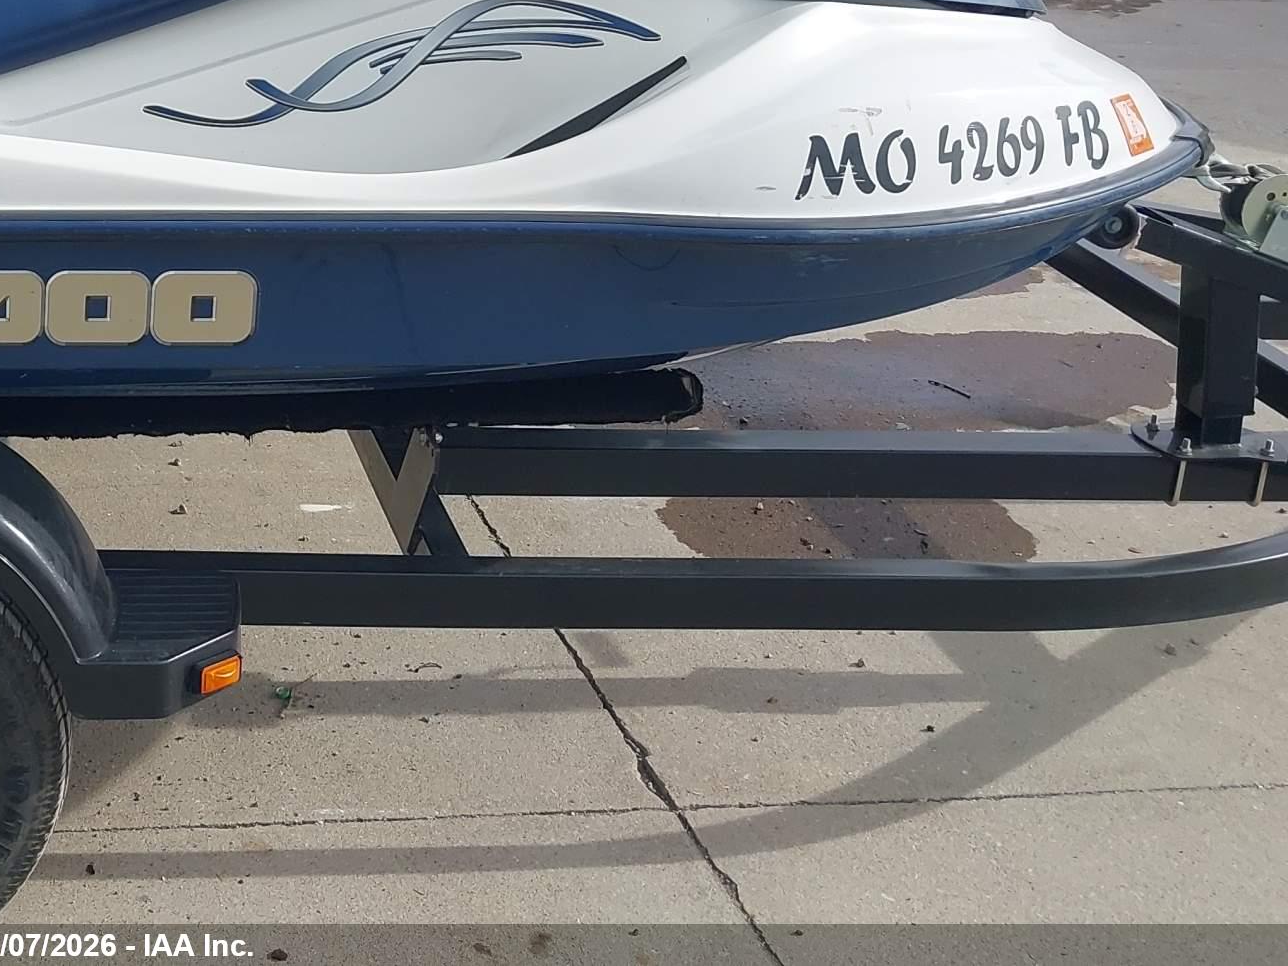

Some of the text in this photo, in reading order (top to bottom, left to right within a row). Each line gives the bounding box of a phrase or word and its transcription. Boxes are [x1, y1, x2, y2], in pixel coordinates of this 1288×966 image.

[794, 128, 917, 201] MO
[938, 115, 1046, 185] 4269
[1055, 100, 1110, 171] FB
